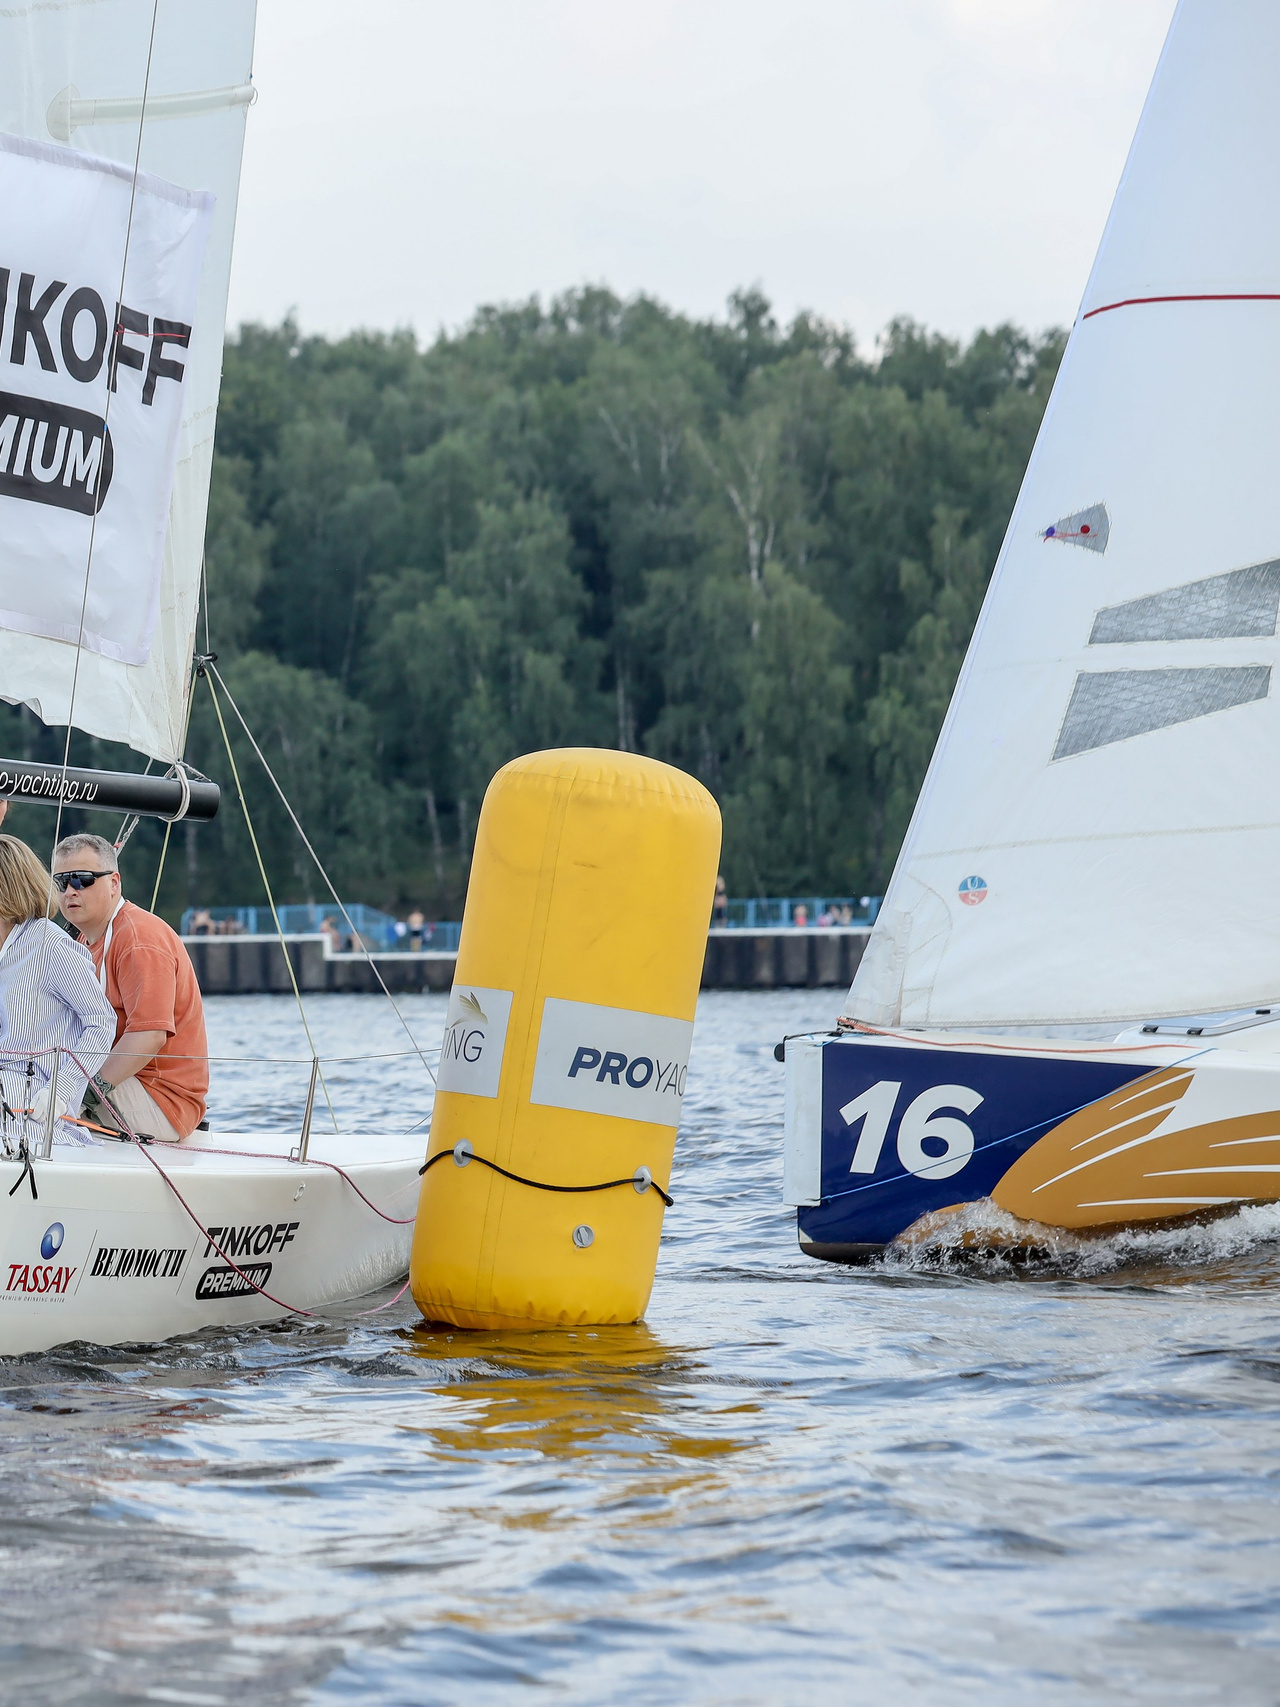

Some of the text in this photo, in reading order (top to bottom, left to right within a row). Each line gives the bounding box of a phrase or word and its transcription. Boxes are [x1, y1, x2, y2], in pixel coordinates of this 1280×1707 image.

[838, 1080, 985, 1180] 16
[203, 1221, 300, 1258] TINKOFF
[5, 1263, 78, 1294] TASSAY
[89, 1247, 188, 1281] ВЕДОМОСТИ
[199, 1267, 269, 1294] PREMIUM
